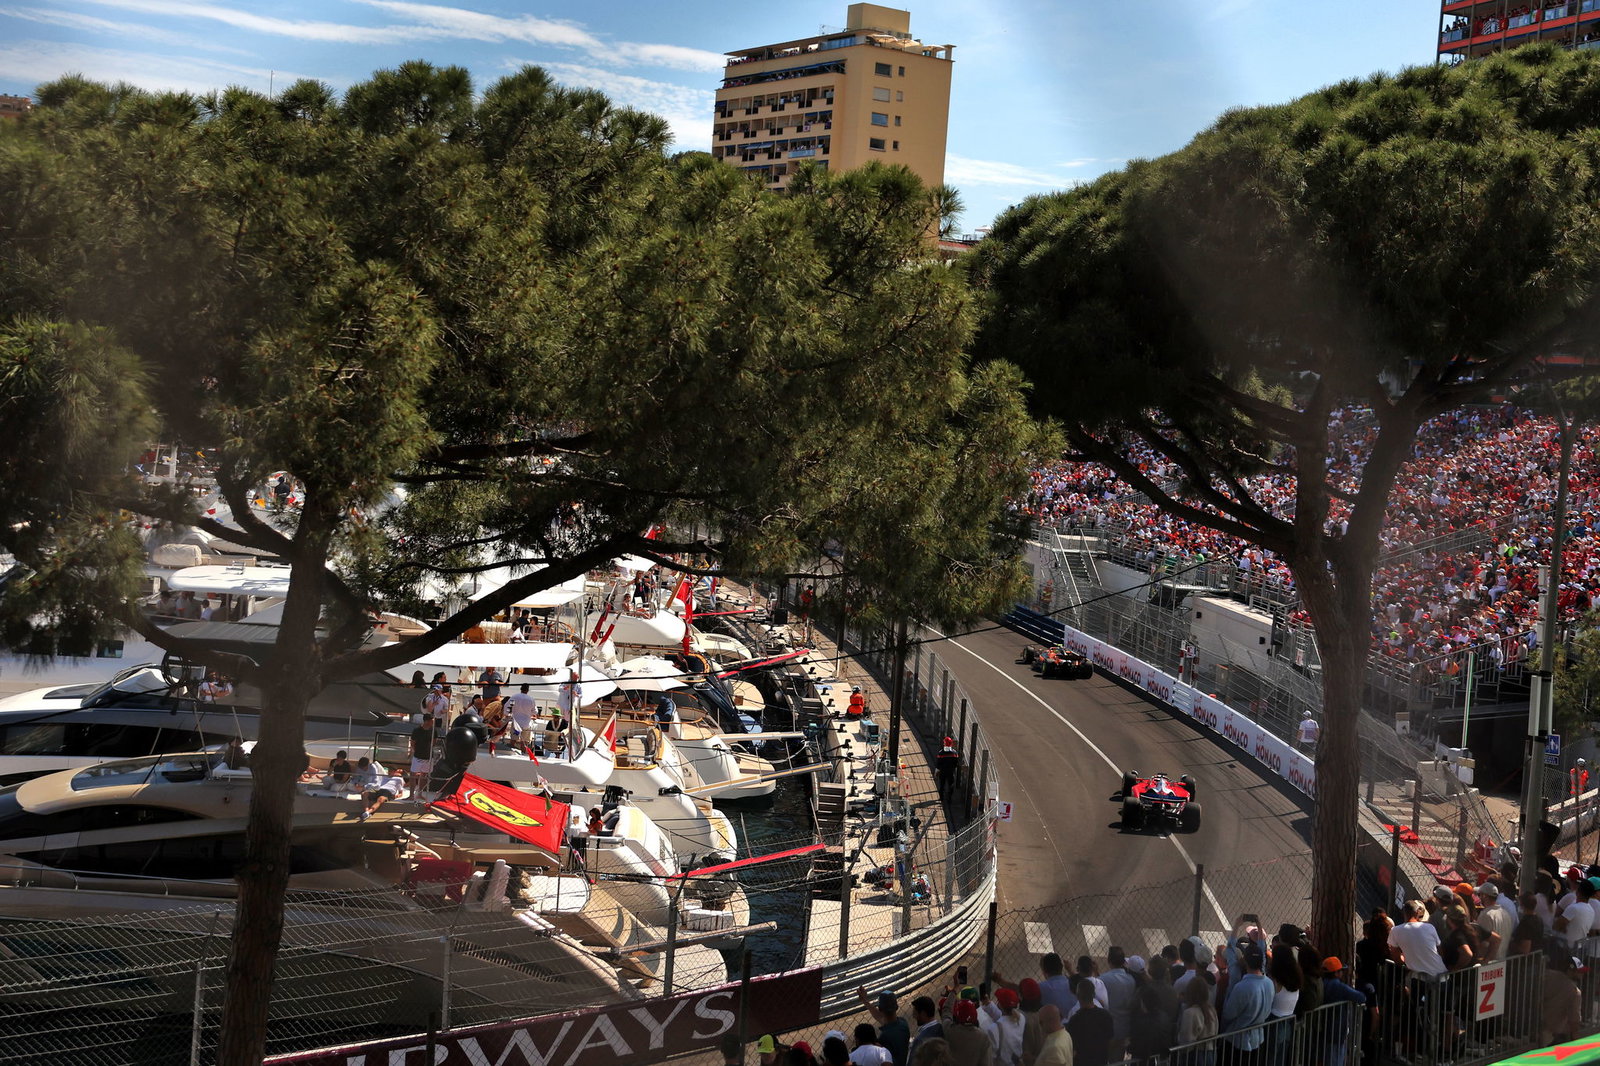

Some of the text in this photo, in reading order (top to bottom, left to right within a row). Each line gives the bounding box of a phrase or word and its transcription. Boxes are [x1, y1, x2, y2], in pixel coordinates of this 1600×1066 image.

[1067, 639, 1088, 656] MONACO
[1092, 652, 1114, 670] MONACO
[1119, 664, 1142, 685] MONACO
[1147, 679, 1169, 701] MONACO
[1193, 705, 1218, 728] MONACO
[1223, 723, 1249, 749] MONACO
[1255, 744, 1281, 772] MONACO
[1481, 967, 1504, 982] TRIBUNE
[1479, 982, 1496, 1014] Z
